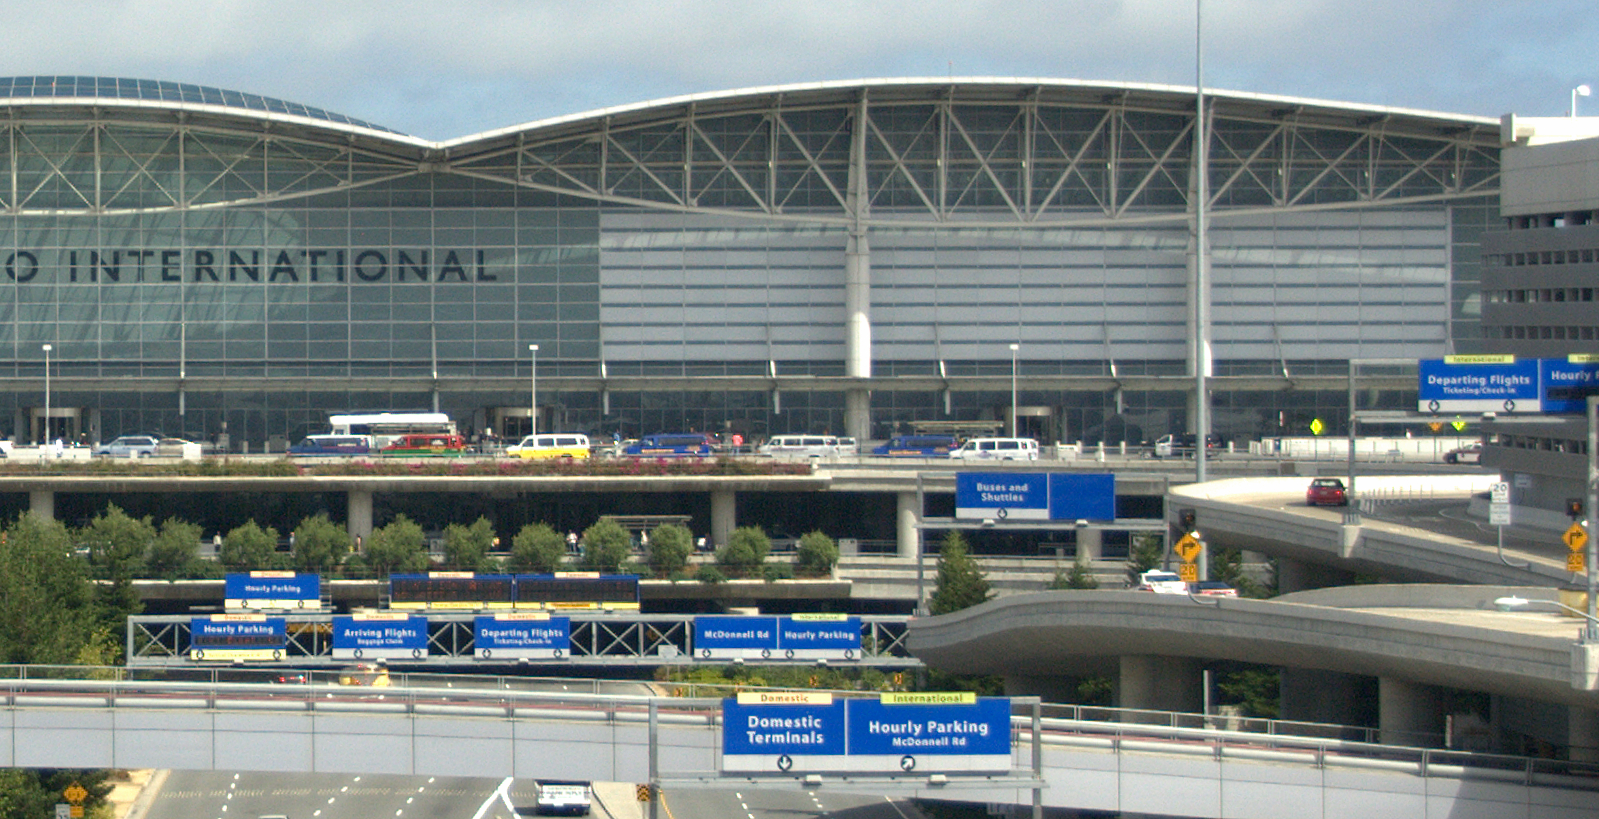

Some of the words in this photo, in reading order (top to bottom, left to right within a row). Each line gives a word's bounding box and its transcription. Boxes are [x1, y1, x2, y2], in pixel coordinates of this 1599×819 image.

[69, 250, 498, 282] INTERNATIONAL
[1428, 375, 1486, 386] Departing
[1490, 375, 1530, 386] Flights
[1551, 370, 1591, 382] Hourly
[977, 483, 1006, 492] Buses
[1009, 483, 1028, 492] and
[1493, 484, 1507, 492] 20
[981, 493, 1024, 502] Shuttles
[204, 625, 235, 635] Hourly
[238, 625, 274, 635] Parking
[344, 629, 382, 638] Arriving
[385, 629, 416, 638] Flights
[481, 629, 528, 638] Departing
[531, 629, 563, 638] Flights
[704, 630, 754, 639] McDonnell
[757, 630, 769, 639] Rd
[785, 631, 815, 640] Hourly
[819, 631, 855, 641] Parking
[761, 693, 809, 703] Domestic
[893, 693, 963, 704] International
[748, 715, 822, 728] Domestic
[869, 720, 922, 736] Hourly
[928, 720, 989, 736] Parking
[747, 731, 824, 745] Terminals
[892, 737, 949, 747] McDonnell
[952, 737, 966, 747] Rd
